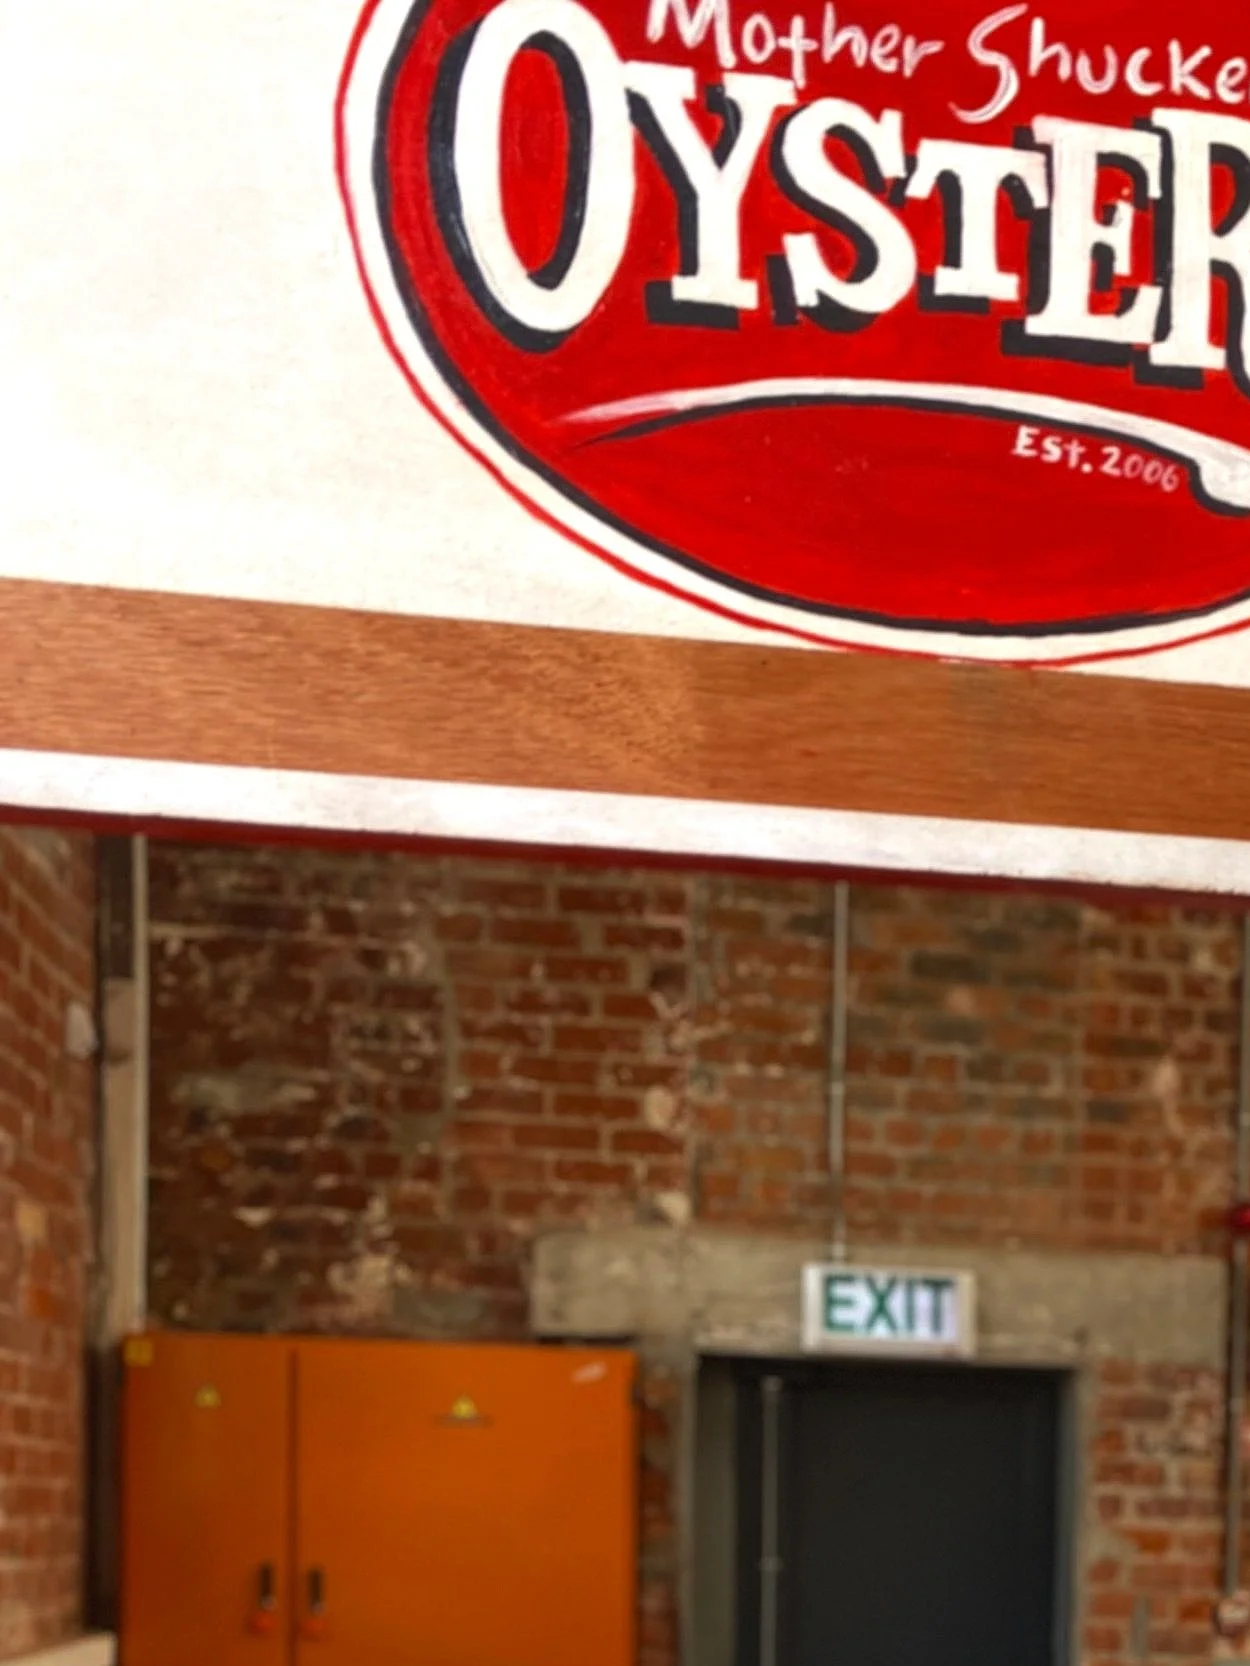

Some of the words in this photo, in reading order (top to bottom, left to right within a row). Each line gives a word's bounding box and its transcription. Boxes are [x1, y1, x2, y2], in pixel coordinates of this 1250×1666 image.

[646, 0, 944, 88] Mother
[1015, 426, 1092, 473] Est.
[1100, 445, 1179, 492] 2006
[823, 1274, 955, 1334] EXIT
